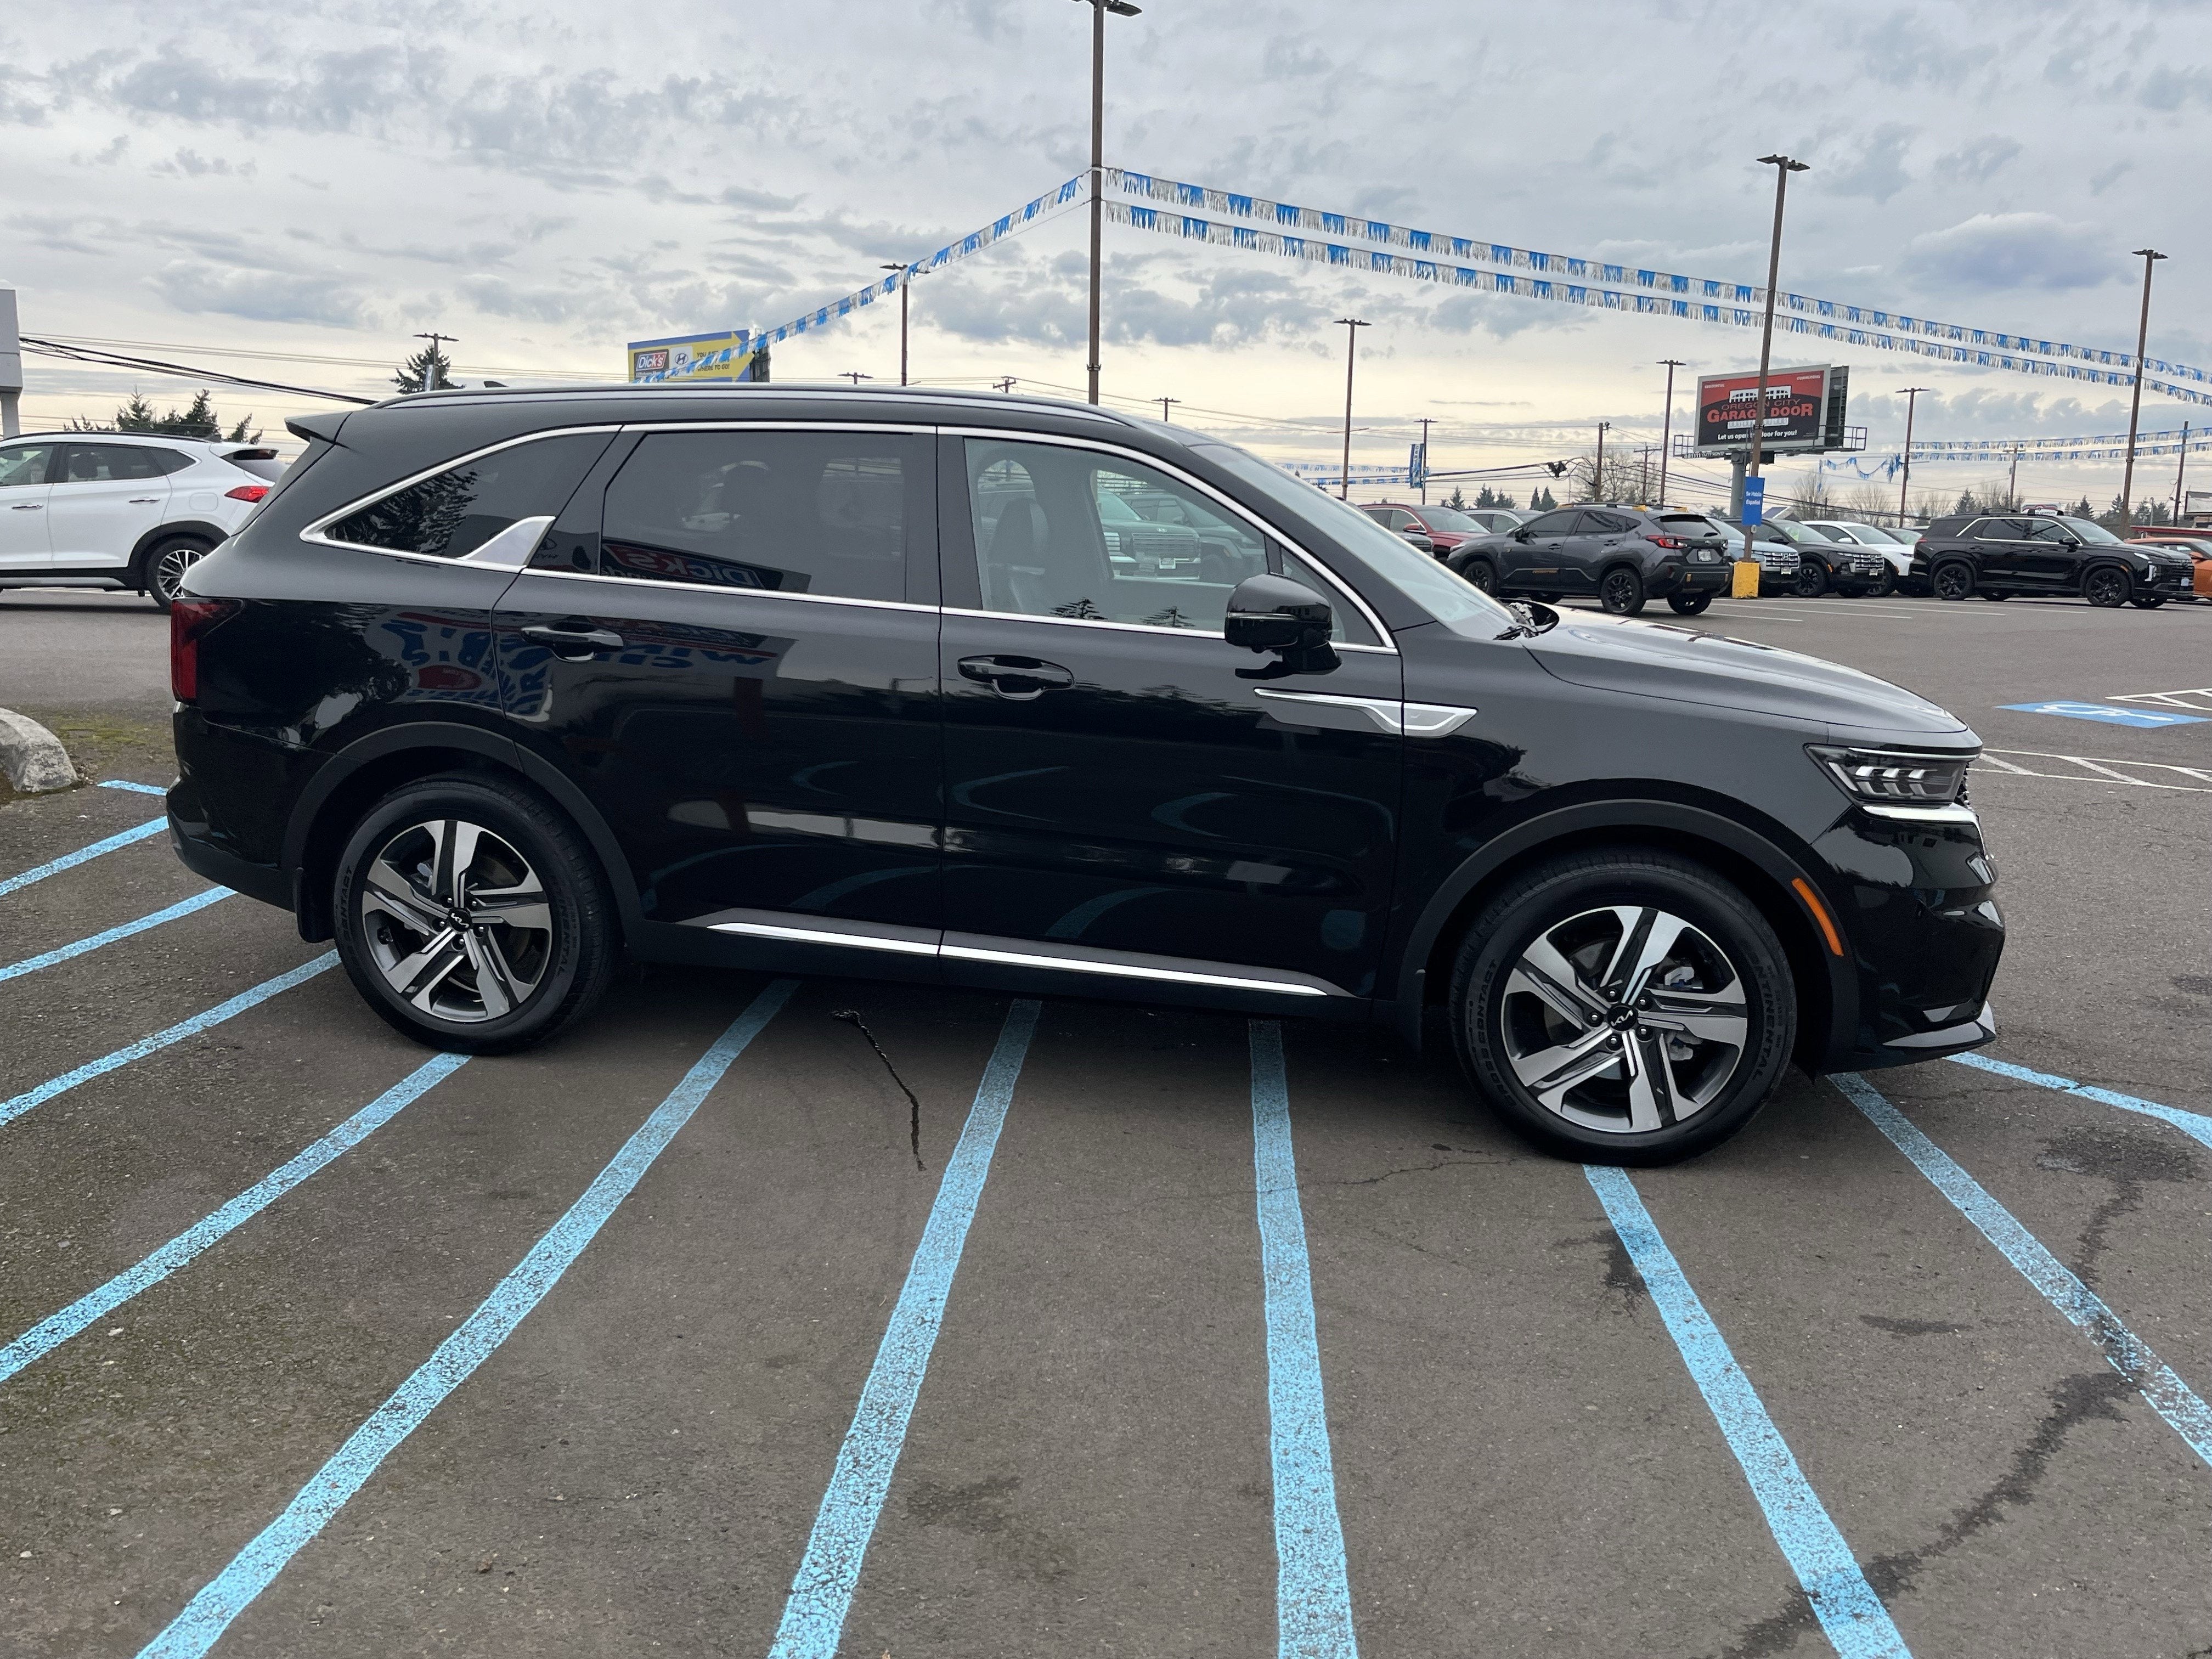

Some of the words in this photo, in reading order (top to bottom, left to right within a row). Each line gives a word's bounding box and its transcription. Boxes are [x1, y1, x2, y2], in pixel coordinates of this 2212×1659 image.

[638, 354, 664, 368] Dick's
[1774, 398, 1801, 407] CITY
[1707, 409, 1758, 422] GARAG
[1770, 403, 1813, 417] DOOR
[1784, 429, 1797, 437] you!
